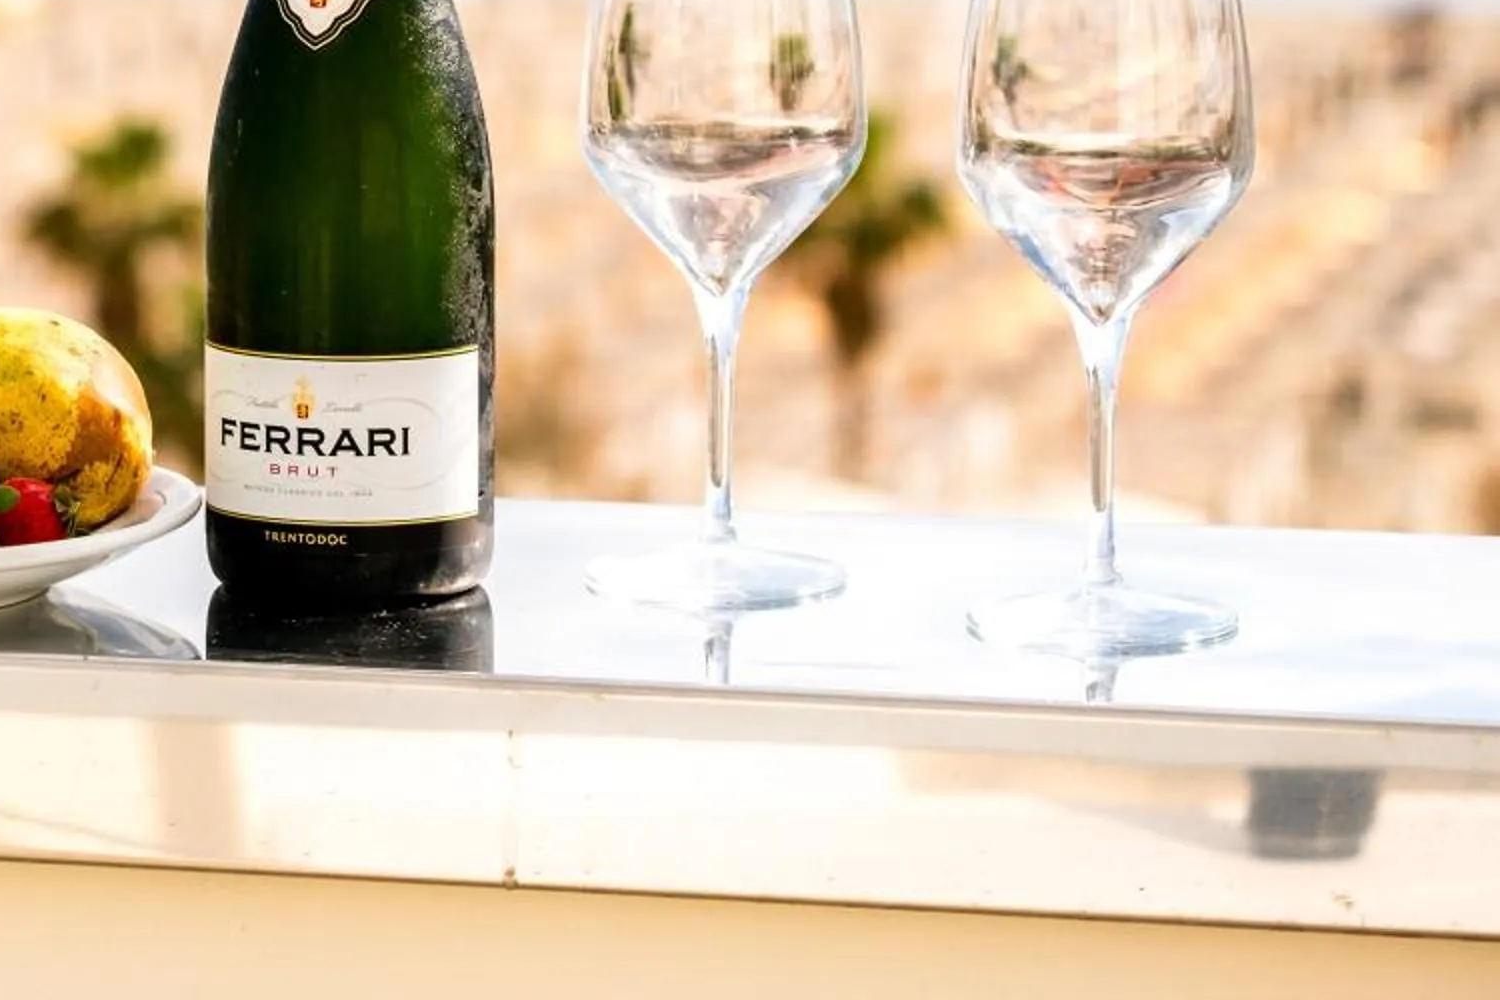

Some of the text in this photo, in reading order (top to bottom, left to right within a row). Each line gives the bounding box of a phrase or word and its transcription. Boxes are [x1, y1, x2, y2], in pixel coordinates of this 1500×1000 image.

[221, 417, 410, 456] FERRARI
[269, 463, 338, 478] BRUT
[264, 530, 348, 546] TRENTODOC
